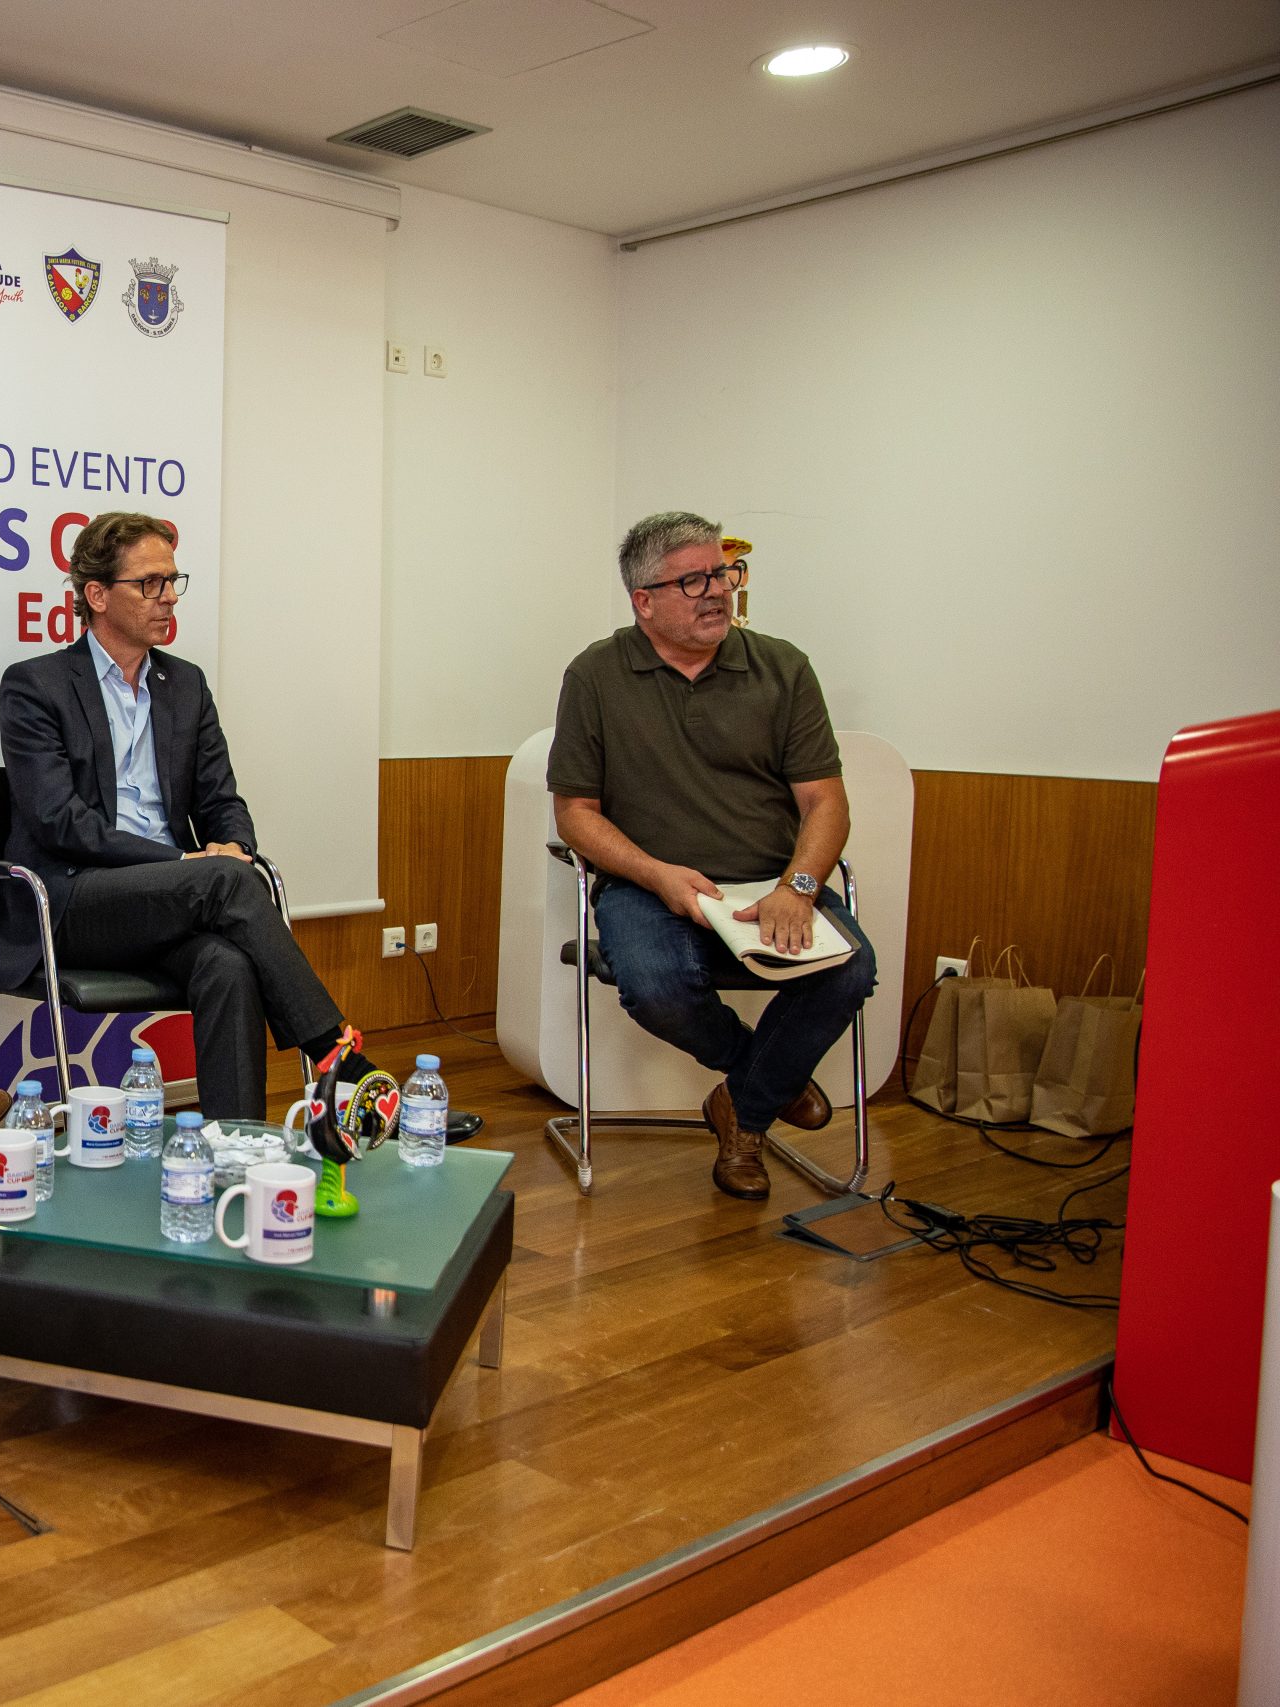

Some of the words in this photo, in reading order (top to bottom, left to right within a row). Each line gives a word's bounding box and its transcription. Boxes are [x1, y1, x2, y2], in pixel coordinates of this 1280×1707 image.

[47, 273, 68, 312] GALEGOS
[77, 279, 98, 314] BARCELOS
[31, 447, 186, 498] EVENTO
